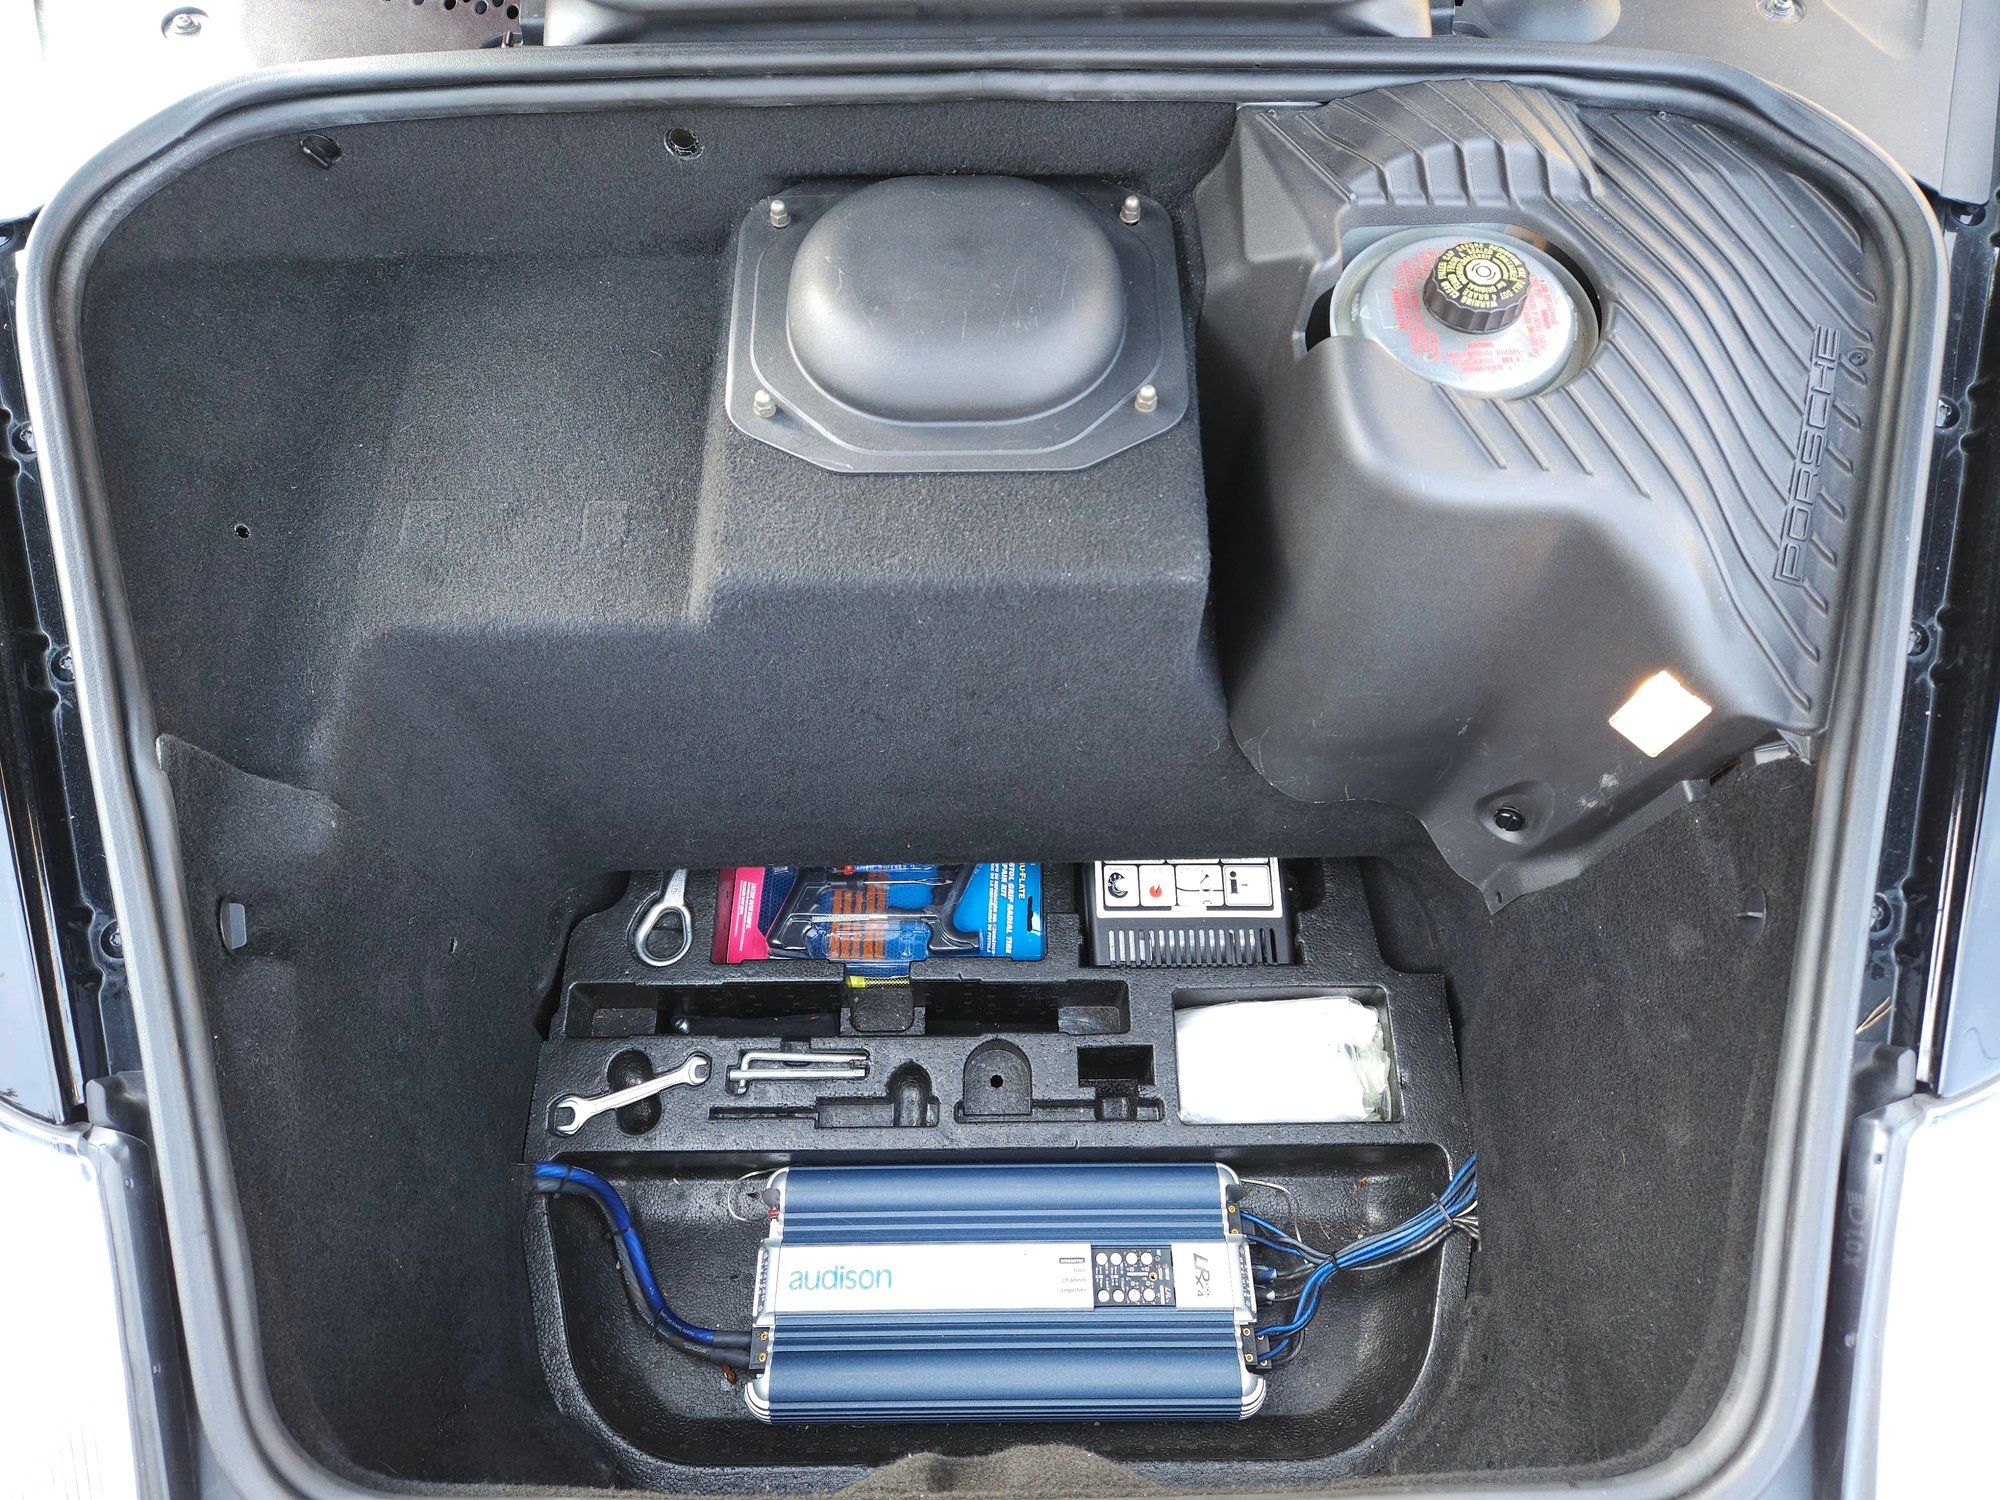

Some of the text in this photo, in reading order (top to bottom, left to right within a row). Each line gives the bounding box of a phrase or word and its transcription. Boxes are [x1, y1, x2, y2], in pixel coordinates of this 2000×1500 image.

[1456, 243, 1484, 252] BEFORE
[1437, 261, 1447, 280] FILLER
[1460, 296, 1498, 308] WARNING
[1781, 326, 1839, 580] PORSCHE
[789, 1265, 892, 1290] audison
